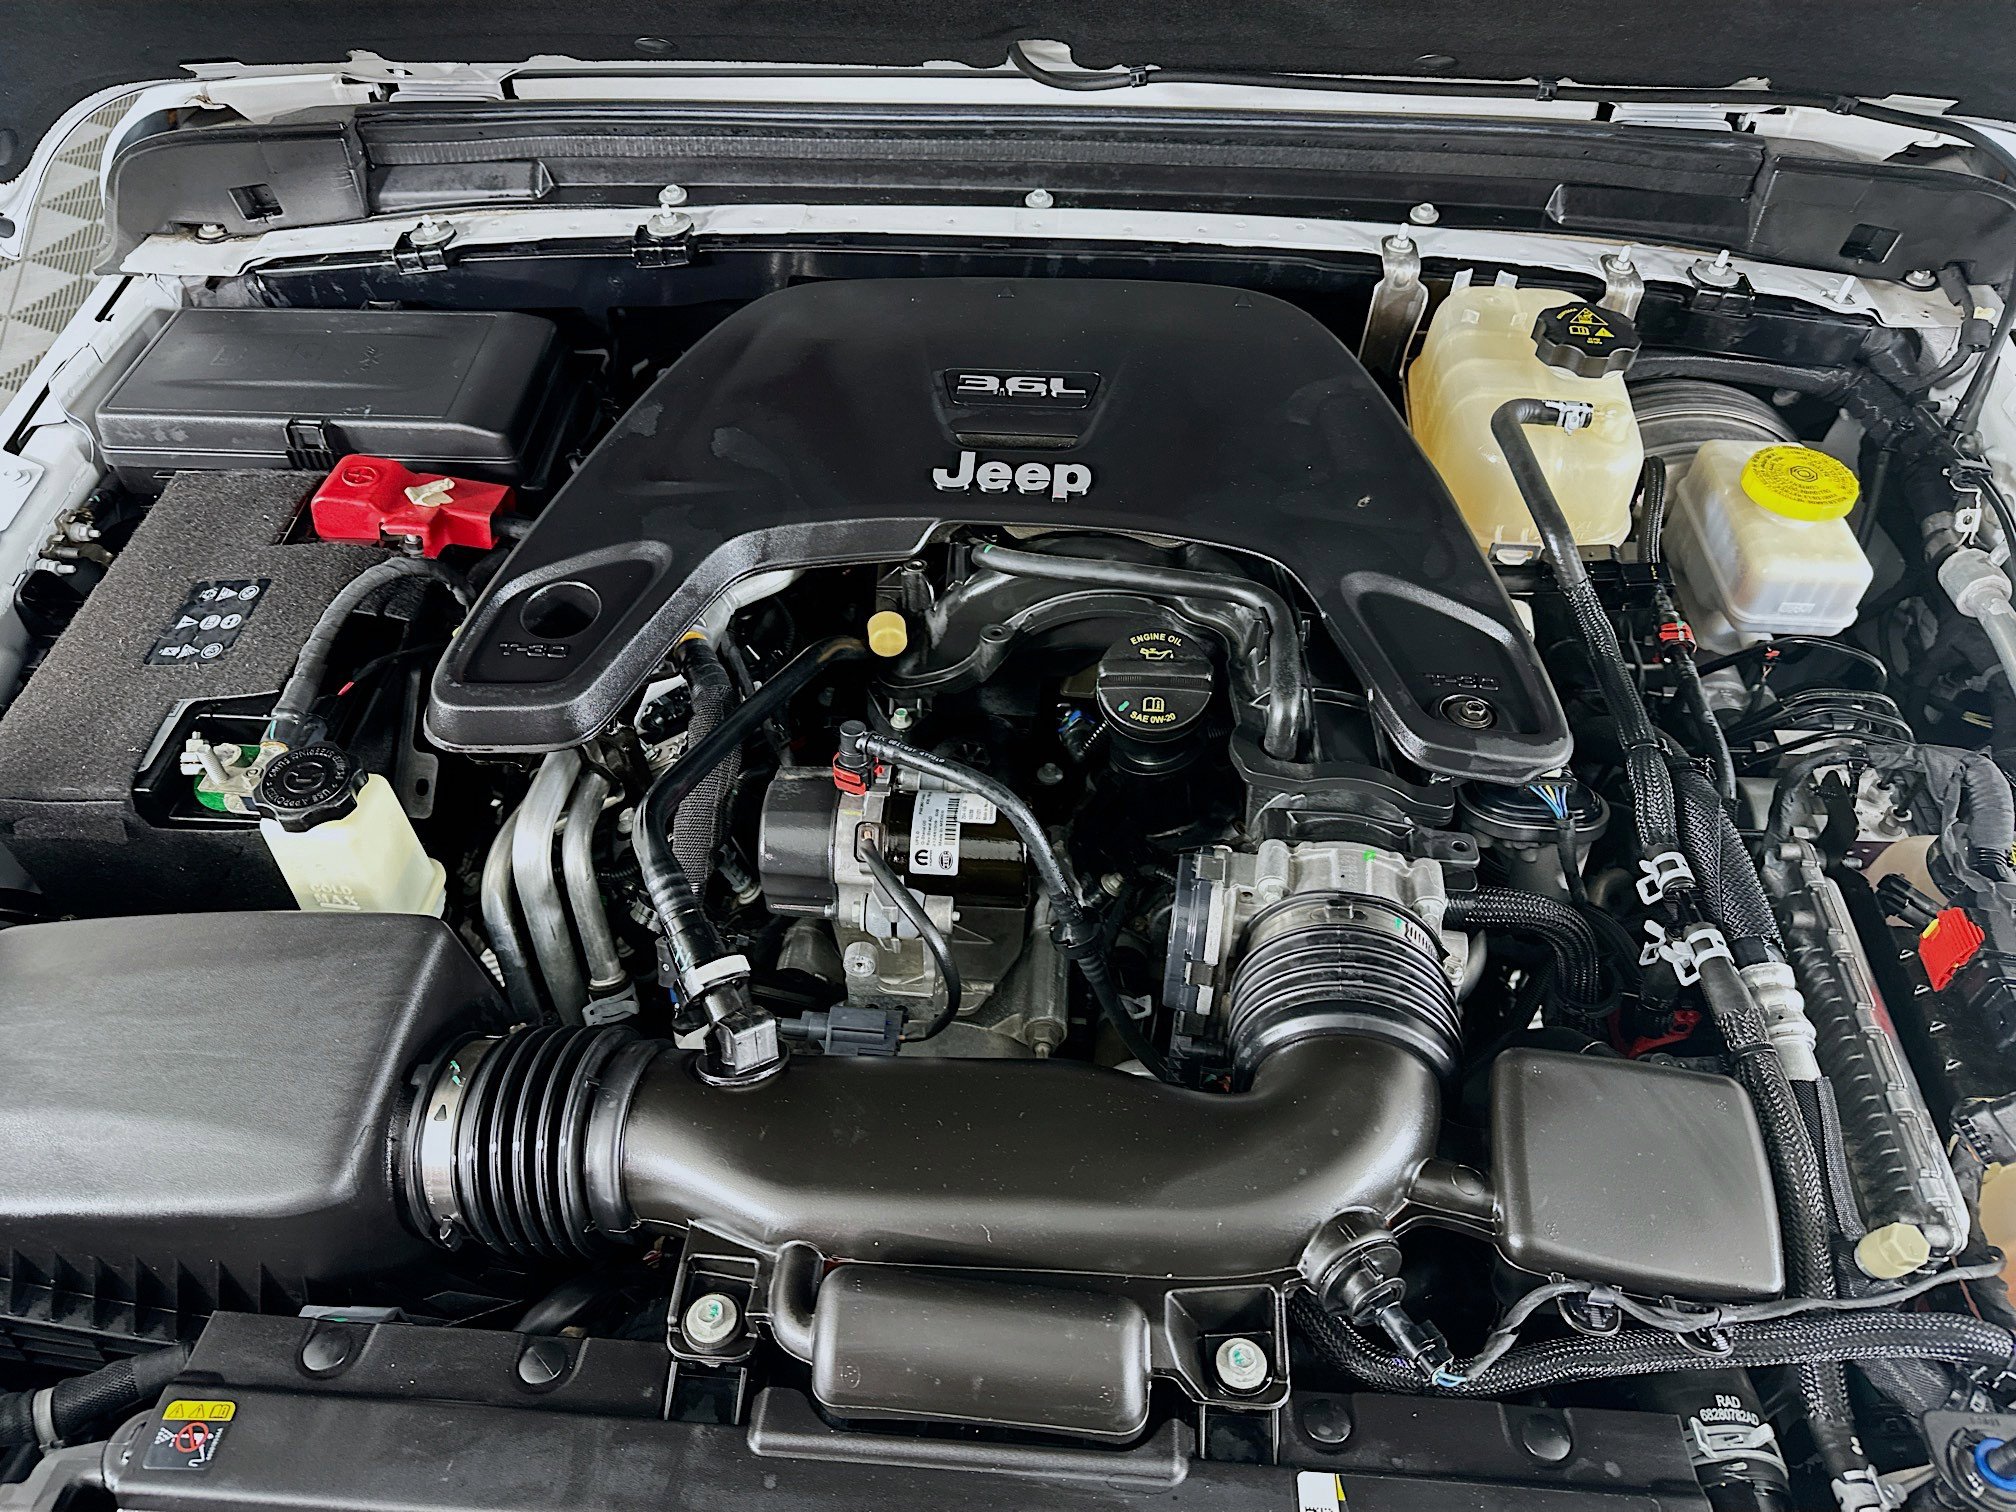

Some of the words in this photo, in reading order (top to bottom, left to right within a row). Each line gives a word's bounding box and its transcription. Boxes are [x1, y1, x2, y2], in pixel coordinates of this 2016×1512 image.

[956, 374, 1087, 399] 3.6L
[932, 450, 1093, 502] Jeep
[1129, 632, 1167, 646] ENGINE
[1167, 634, 1183, 647] OIL
[1129, 710, 1149, 723] SAE
[1150, 712, 1177, 724] 0W-20
[309, 881, 353, 895] COLD
[313, 892, 359, 906] MAX
[1715, 1394, 1741, 1408] RAD
